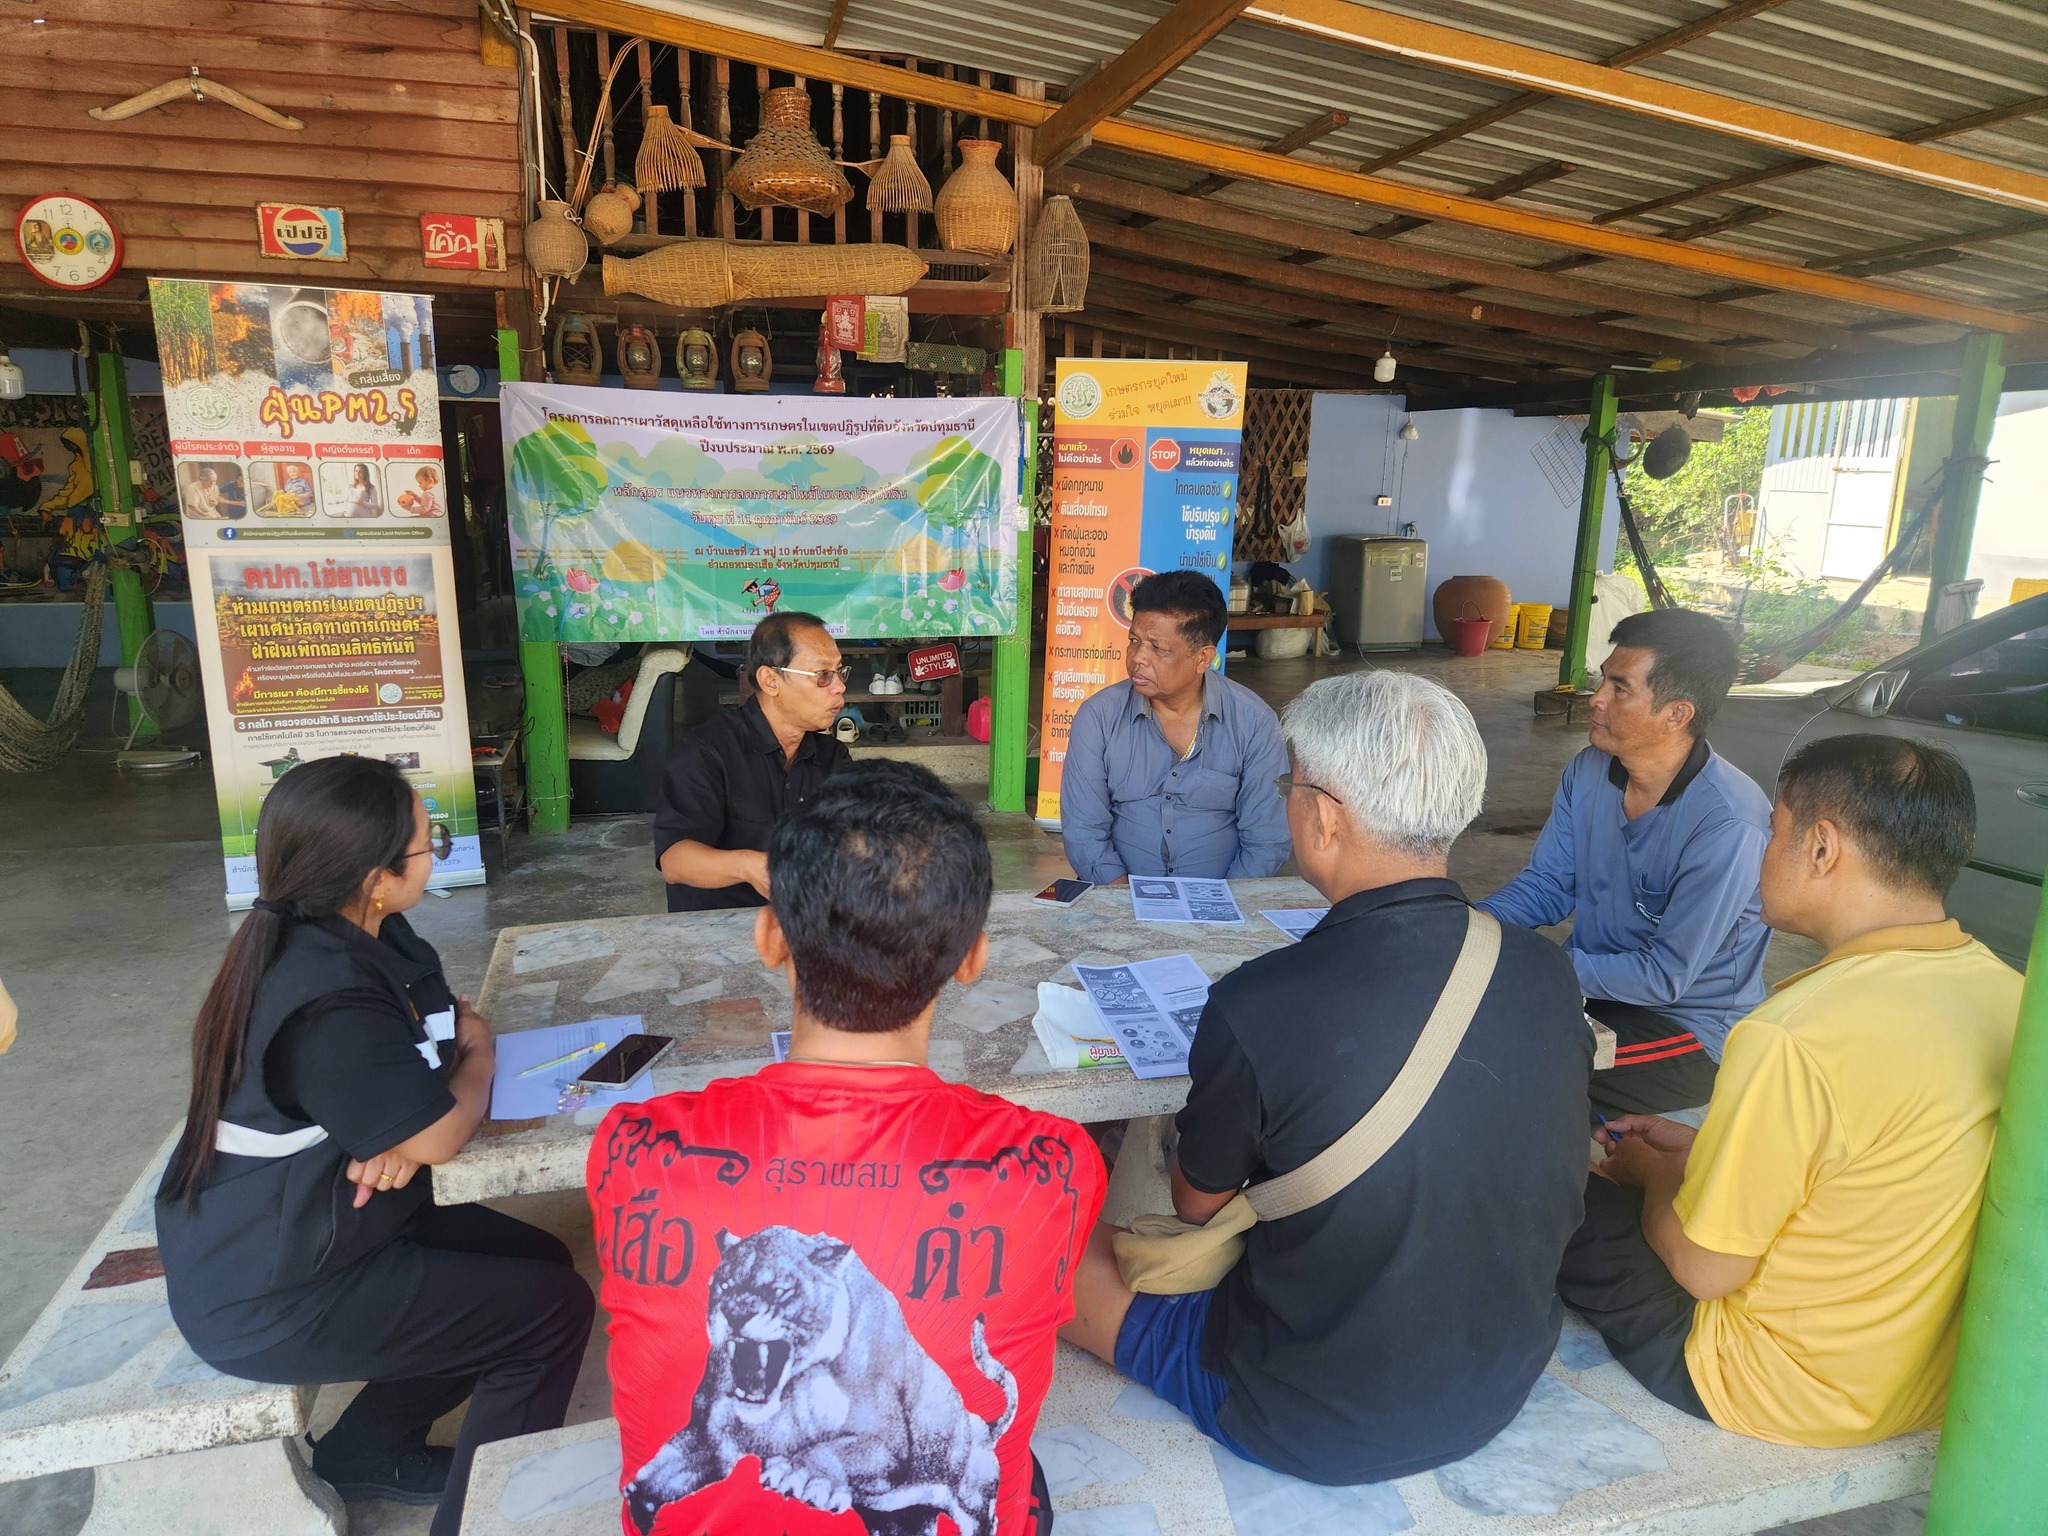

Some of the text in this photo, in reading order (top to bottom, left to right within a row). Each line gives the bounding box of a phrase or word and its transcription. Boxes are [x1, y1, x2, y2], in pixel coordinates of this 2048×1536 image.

[60, 203, 73, 216] 12
[69, 270, 80, 281] 6
[87, 266, 97, 278] 5
[359, 371, 401, 386] กลุ่มเสี่ยง
[1105, 368, 1188, 397] เกษตรกรยุคใหม่
[1108, 404, 1140, 420] ร่วมใจ
[261, 442, 296, 455] ผู้สูงอายุ
[407, 446, 421, 455] เด็ก
[699, 439, 774, 454] ปีงบประมาณ
[805, 444, 835, 455] 2569
[1151, 450, 1177, 460] STOP
[1058, 452, 1102, 464] ไม่ดีอย่างไร
[1061, 476, 1104, 495] ผิดกฎหมาย
[1061, 497, 1108, 517] ดินเสื่อมโทรม
[809, 514, 838, 526] 2569
[1182, 505, 1220, 527] ใช้ปรับปรุง
[1060, 525, 1108, 544] เกิดฝุ่นละออง
[1186, 525, 1216, 544] บำรุงดิน
[706, 544, 746, 556] บ้านเลขที่
[750, 547, 761, 556] 21
[764, 545, 776, 558] หมู่
[779, 547, 790, 556] 10
[1059, 543, 1096, 558] หมอกควัน
[708, 558, 774, 569] อำเภอหนองเสือ
[1179, 550, 1217, 568] นำมาใช้เป็น
[1057, 581, 1104, 602] ทำลายสุขภาพ
[1056, 599, 1098, 618] เป็นอันตราย
[240, 617, 420, 640] เผาเศษวัสดุทางการเกษตร
[1055, 620, 1082, 636] ต่อชีวิต
[251, 636, 416, 660] ฝ่าฝืนเพิกถอนสิทธิทันที
[1054, 642, 1122, 661] กระทบการท่องเที่ยว
[915, 651, 953, 665] UNLIMITED
[923, 661, 949, 674] STYLE
[1053, 668, 1105, 686] สูญเสียทางด้าน
[253, 689, 294, 699] มีการเผา
[422, 692, 443, 700] 1764
[1052, 685, 1085, 703] เศรษฐกิจ
[239, 722, 246, 730] 3
[247, 718, 273, 729] กลไก
[274, 714, 340, 728] ตรวจสอบสิทธิ
[341, 708, 440, 724] และการใช้ประโยชน์ที่ดิน
[612, 1189, 1005, 1301] เสือ ดำ
